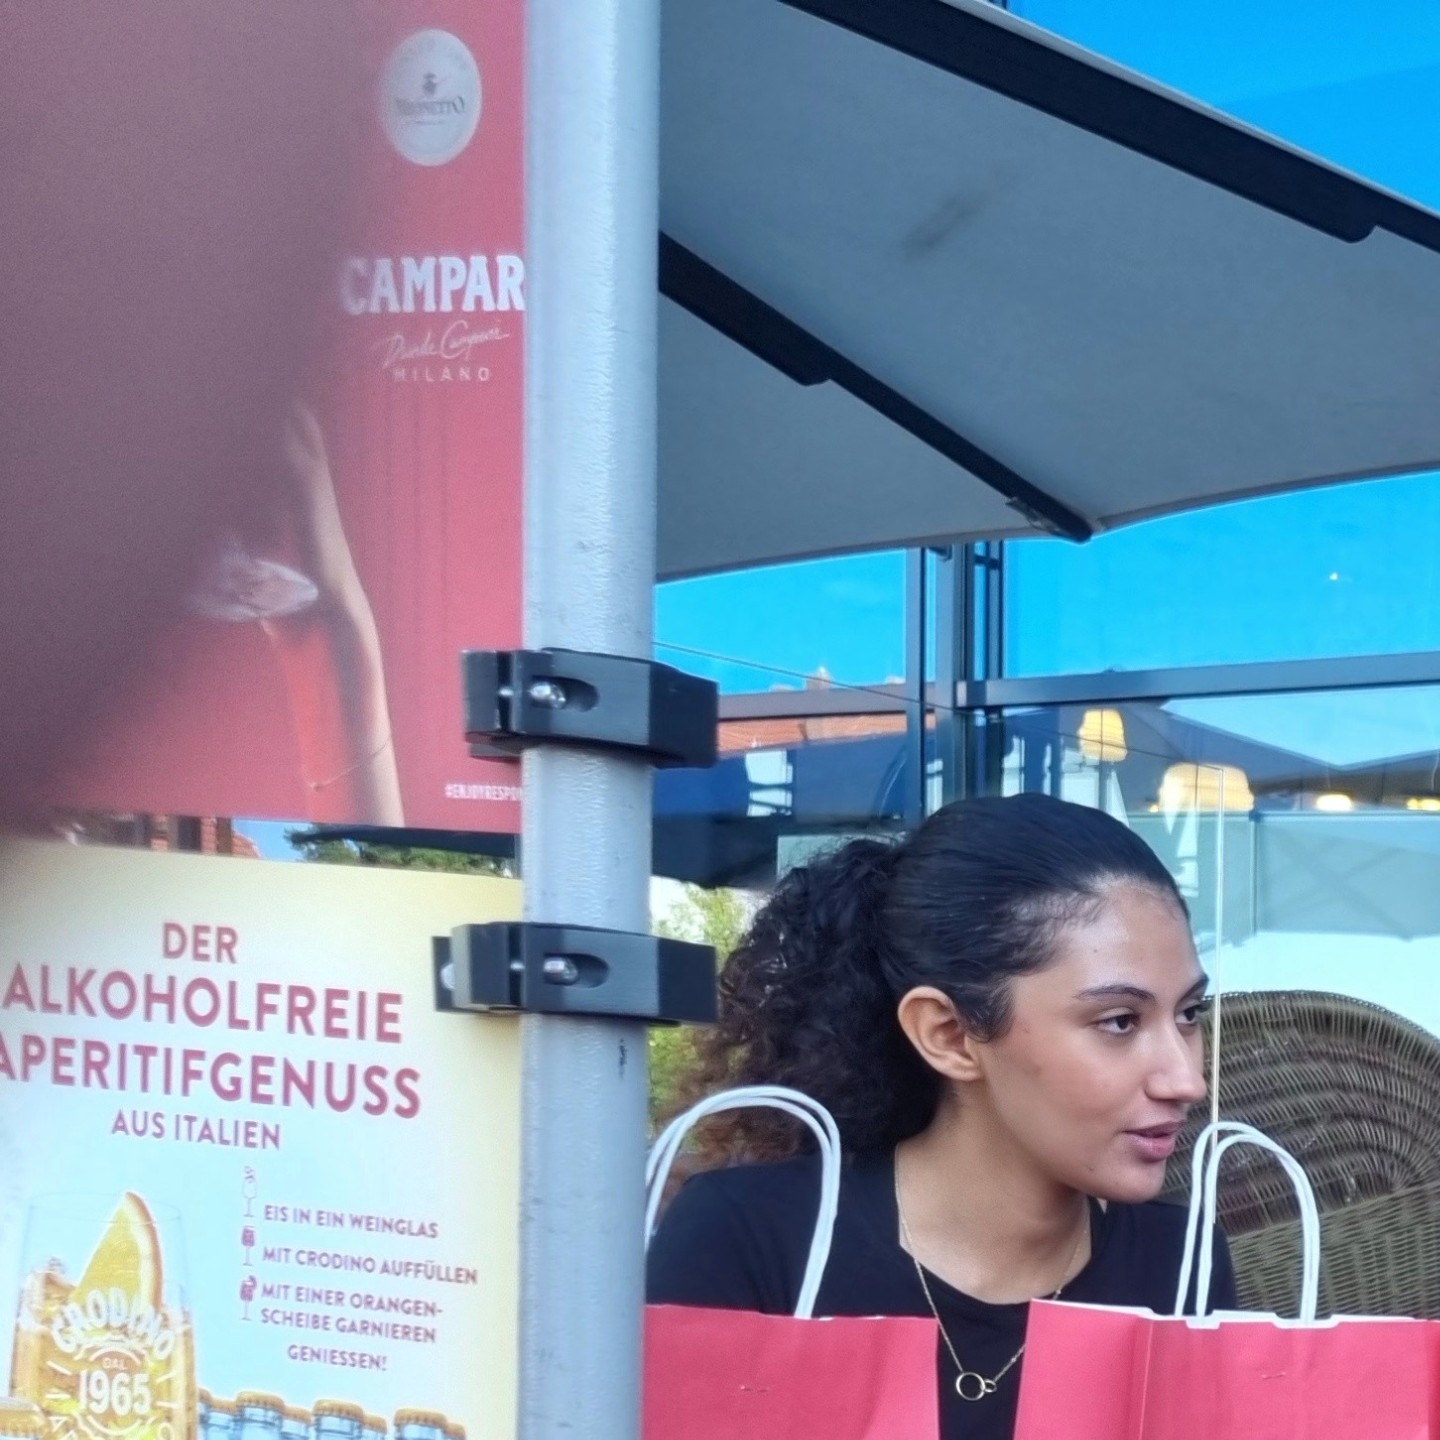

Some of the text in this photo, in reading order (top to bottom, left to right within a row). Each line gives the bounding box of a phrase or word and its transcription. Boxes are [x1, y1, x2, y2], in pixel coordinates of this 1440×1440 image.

[342, 255, 526, 315] CAMPAR
[162, 922, 238, 964] DER
[2, 962, 403, 1044] ALKOHOLFREIE
[111, 1109, 281, 1150] AUS ITALIEN
[264, 1204, 439, 1239] EIS IN EIN WEINGLAS
[262, 1247, 478, 1285] MIT CRODINO AUFFÜLLEN
[261, 1283, 443, 1317] MIT EINER ORANGEN-
[260, 1308, 437, 1344] SCHEIBE GARNIEREN
[287, 1344, 388, 1372] GENIESSEN!
[79, 1369, 151, 1417] 1965
